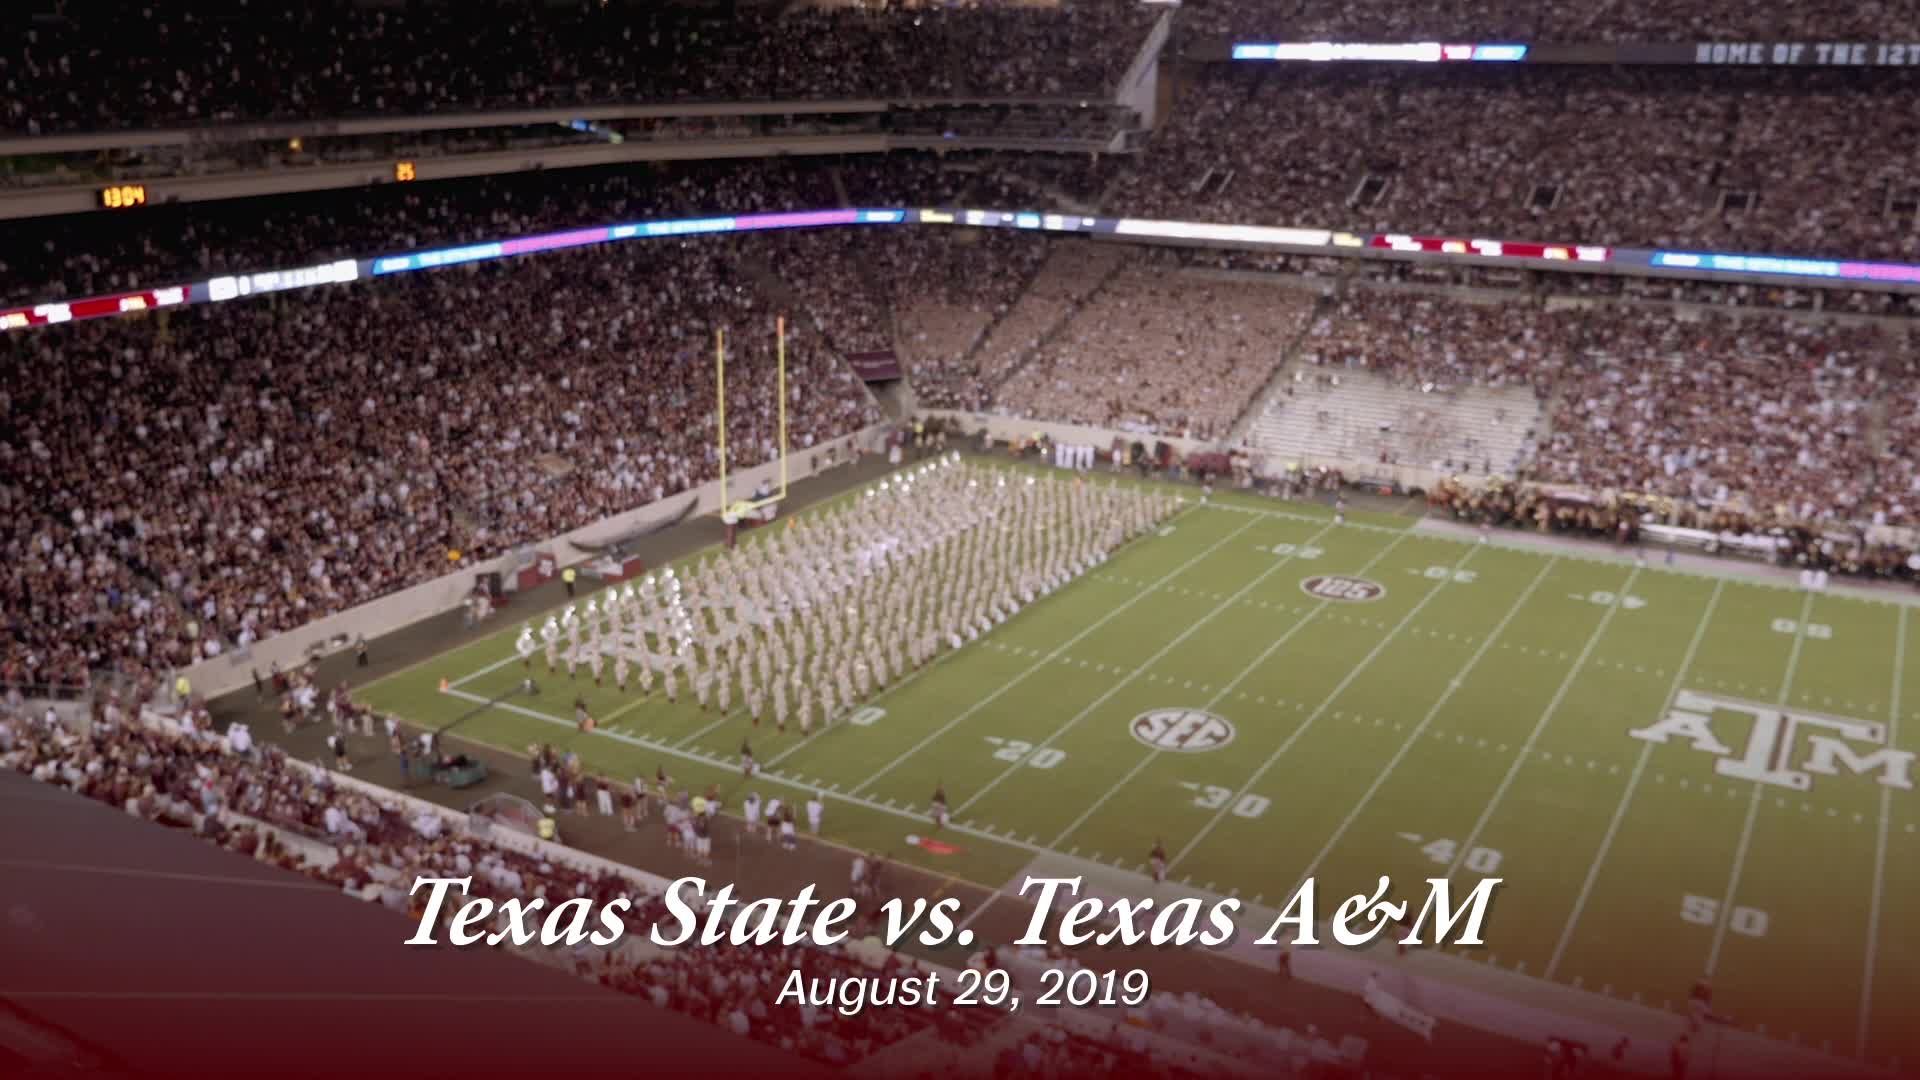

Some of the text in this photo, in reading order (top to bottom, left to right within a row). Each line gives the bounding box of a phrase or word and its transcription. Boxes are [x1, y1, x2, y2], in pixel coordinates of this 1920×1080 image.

[1695, 42, 1764, 64] HOME
[1773, 42, 1805, 64] OF
[1815, 43, 1867, 65] THE
[1133, 709, 1231, 751] SEC
[993, 740, 1067, 769] 20
[1193, 786, 1271, 818] 30
[1421, 837, 1503, 875] 40
[1680, 891, 1769, 938] 50
